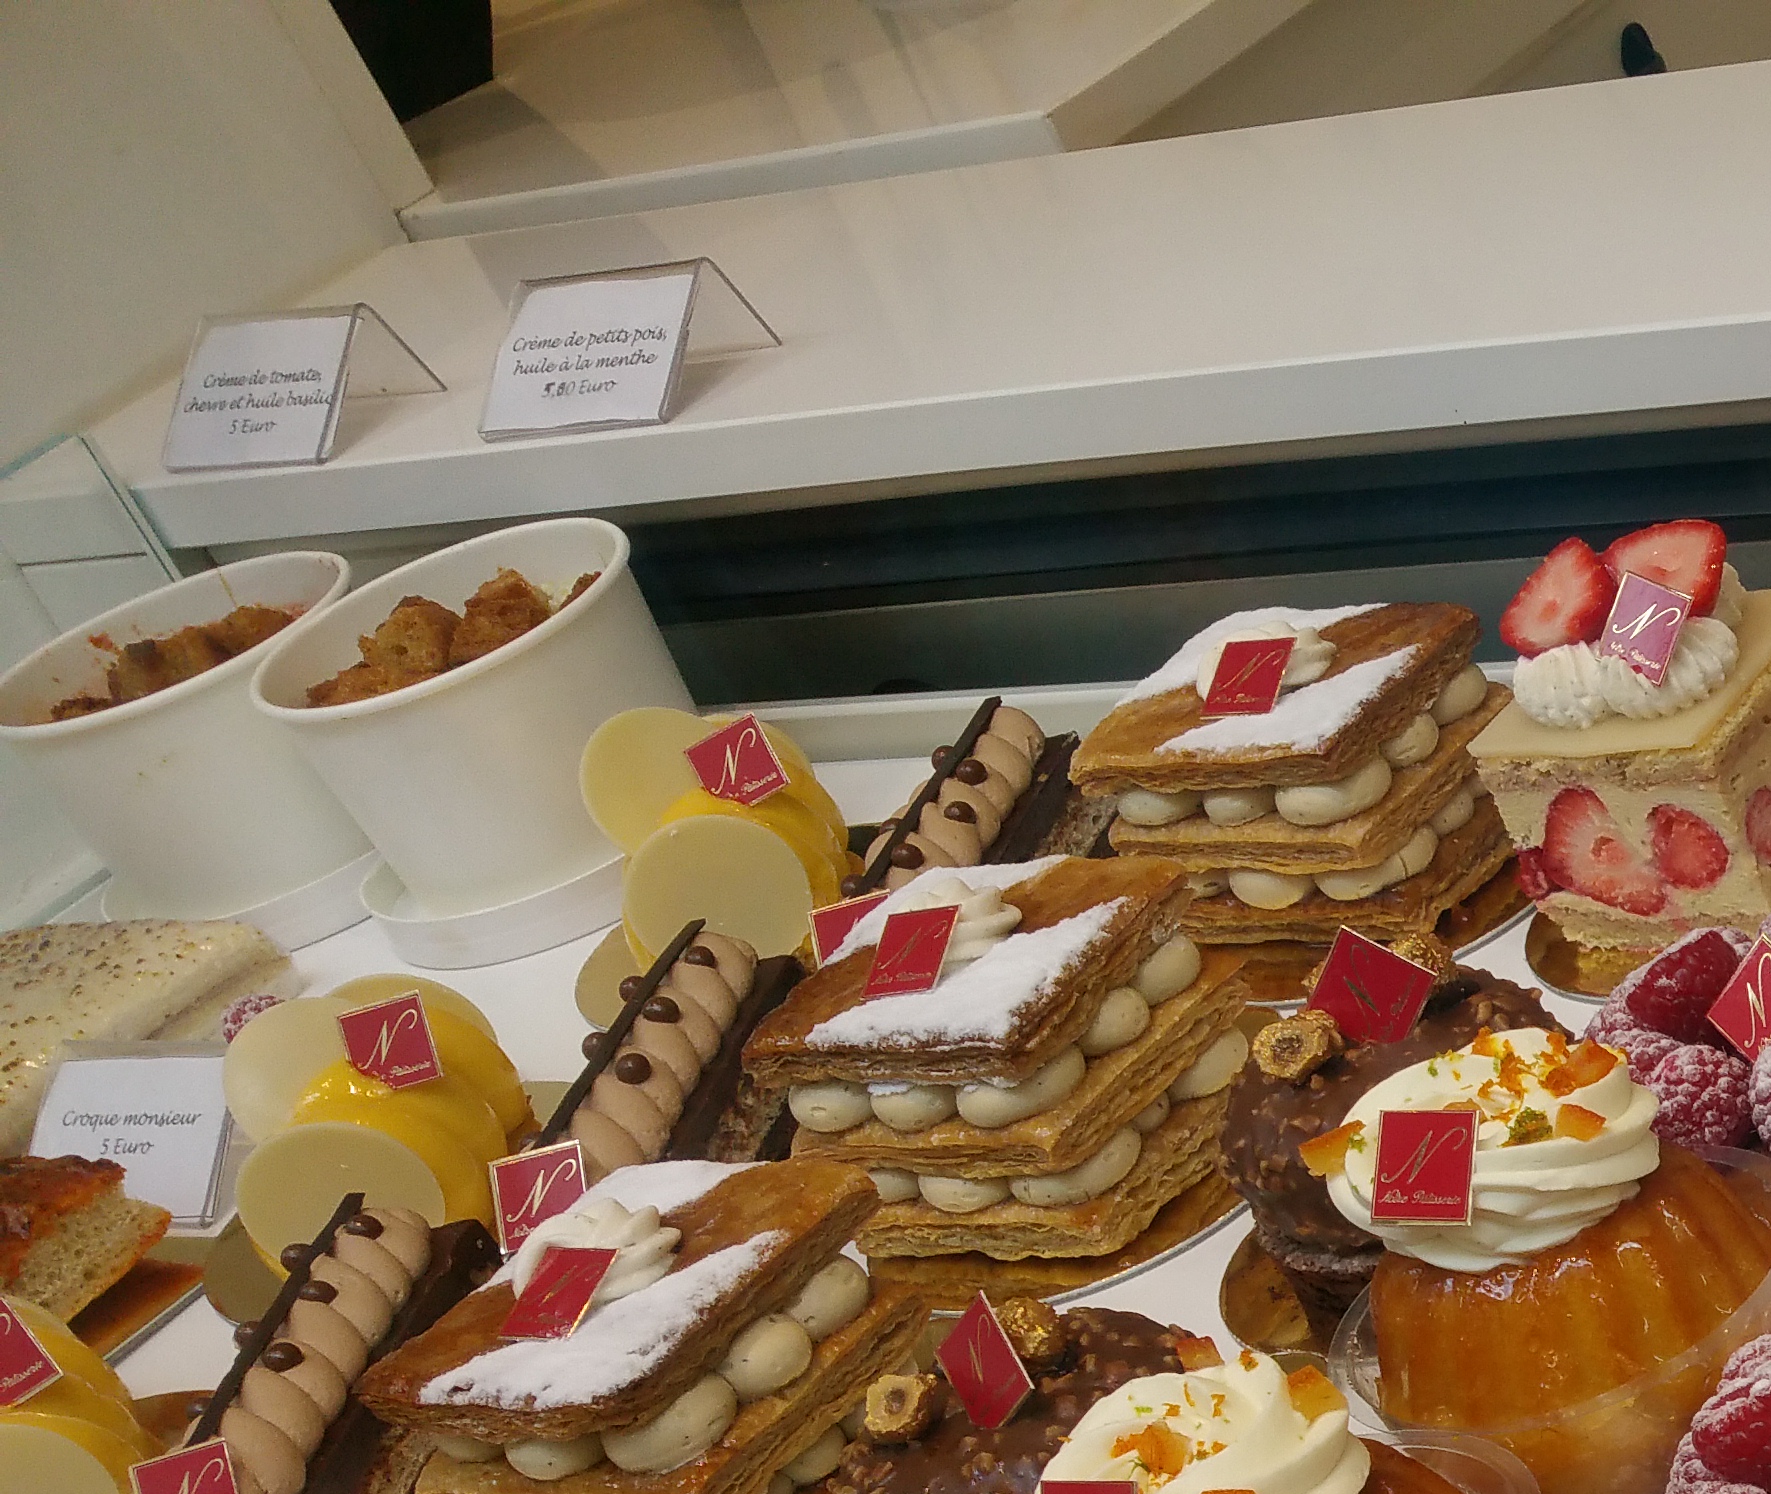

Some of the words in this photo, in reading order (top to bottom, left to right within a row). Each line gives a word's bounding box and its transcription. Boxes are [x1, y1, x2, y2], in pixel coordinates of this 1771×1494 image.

[513, 336, 563, 352] Crème
[564, 331, 587, 347] de
[586, 329, 632, 351] petits
[513, 358, 559, 376] huile
[559, 356, 576, 372] à
[575, 354, 595, 371] la
[595, 349, 658, 369] menthe
[249, 369, 267, 385] de
[578, 379, 618, 395] Euro
[229, 397, 242, 410] et
[245, 392, 282, 408] huile
[229, 419, 237, 434] 5
[241, 419, 277, 434] Euro
[1612, 603, 1681, 640] N
[710, 728, 756, 794] N
[357, 1008, 417, 1070] N
[62, 1110, 120, 1132] Croque
[123, 1111, 202, 1128] monsieur
[100, 1138, 109, 1155] 5
[113, 1138, 154, 1155] Euro
[1381, 1126, 1468, 1185] N
[506, 1159, 577, 1223] N
